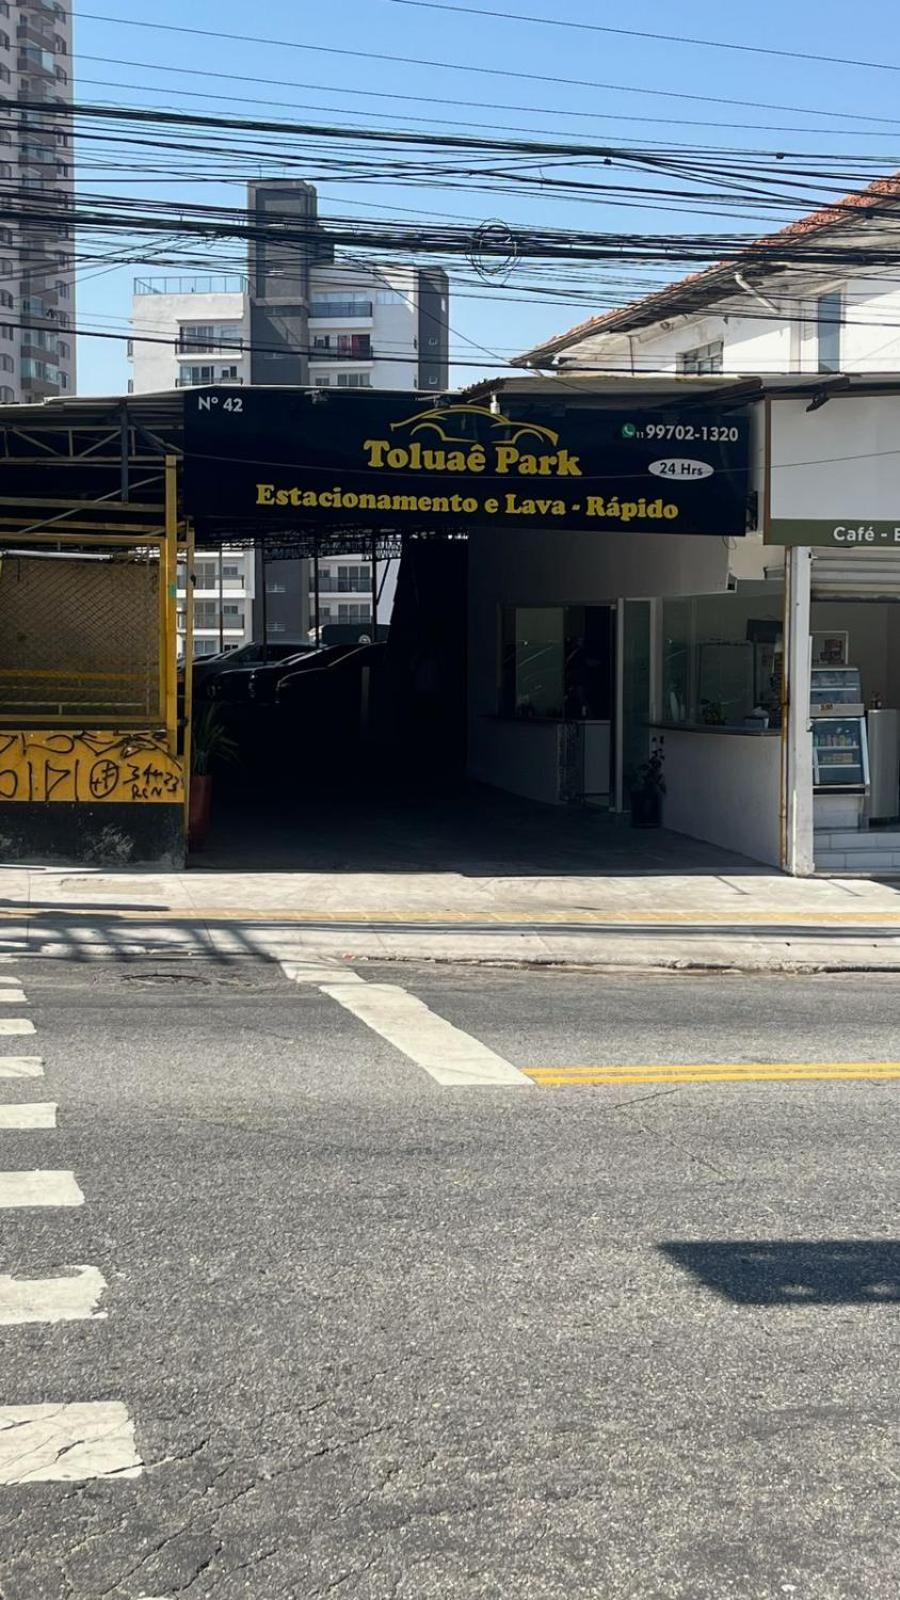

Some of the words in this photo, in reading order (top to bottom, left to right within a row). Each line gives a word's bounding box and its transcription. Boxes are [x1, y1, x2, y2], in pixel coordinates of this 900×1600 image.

[222, 396, 244, 413] 42
[645, 424, 739, 442] 99702-1320
[363, 439, 486, 473] Toluaê
[495, 446, 583, 477] Park
[658, 462, 676, 476] 24
[679, 463, 704, 476] Hrs
[255, 483, 479, 513] Estacionamento
[483, 496, 500, 514] e
[504, 493, 566, 516] Lava
[586, 495, 679, 522] Rápido
[833, 526, 875, 541] Café
